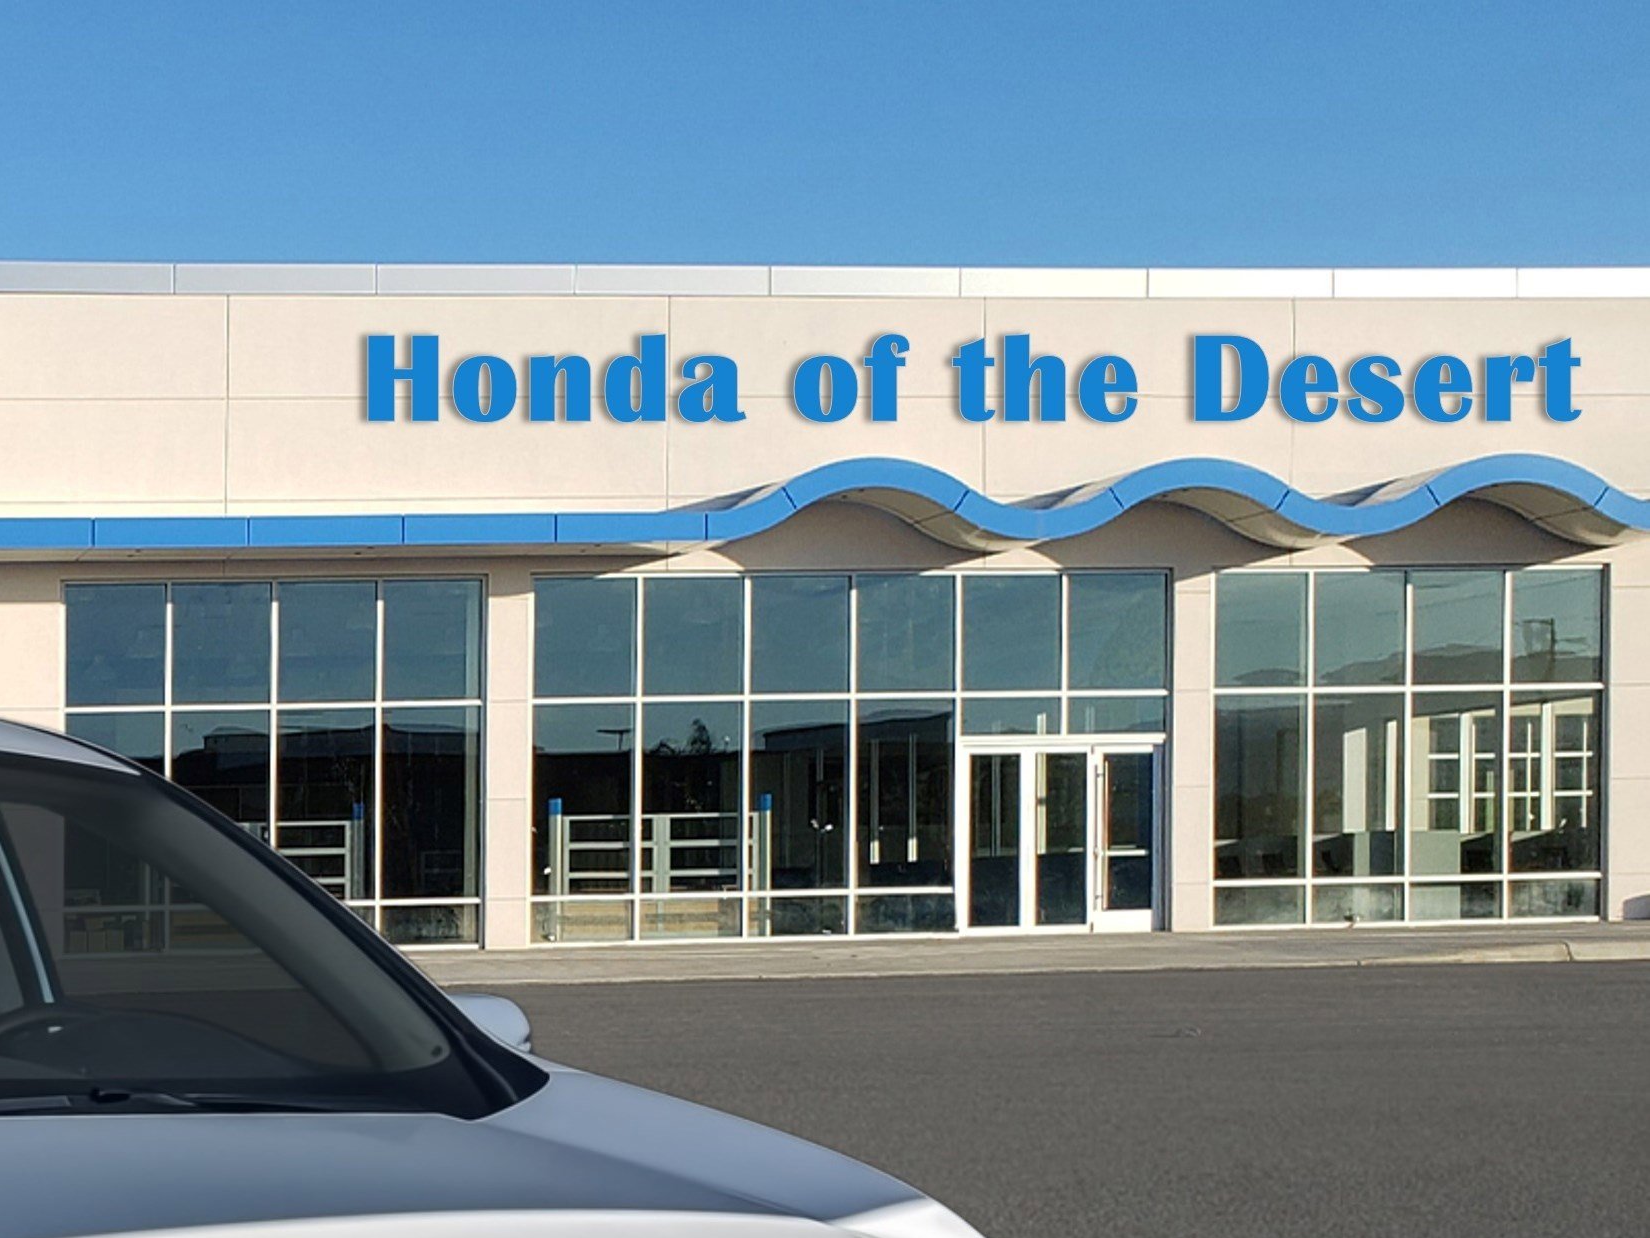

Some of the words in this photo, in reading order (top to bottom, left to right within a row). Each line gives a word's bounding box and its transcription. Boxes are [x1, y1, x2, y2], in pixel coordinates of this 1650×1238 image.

[365, 334, 746, 423] Honda
[792, 334, 910, 423] of
[951, 334, 1138, 423] the
[1192, 334, 1582, 423] Desert
